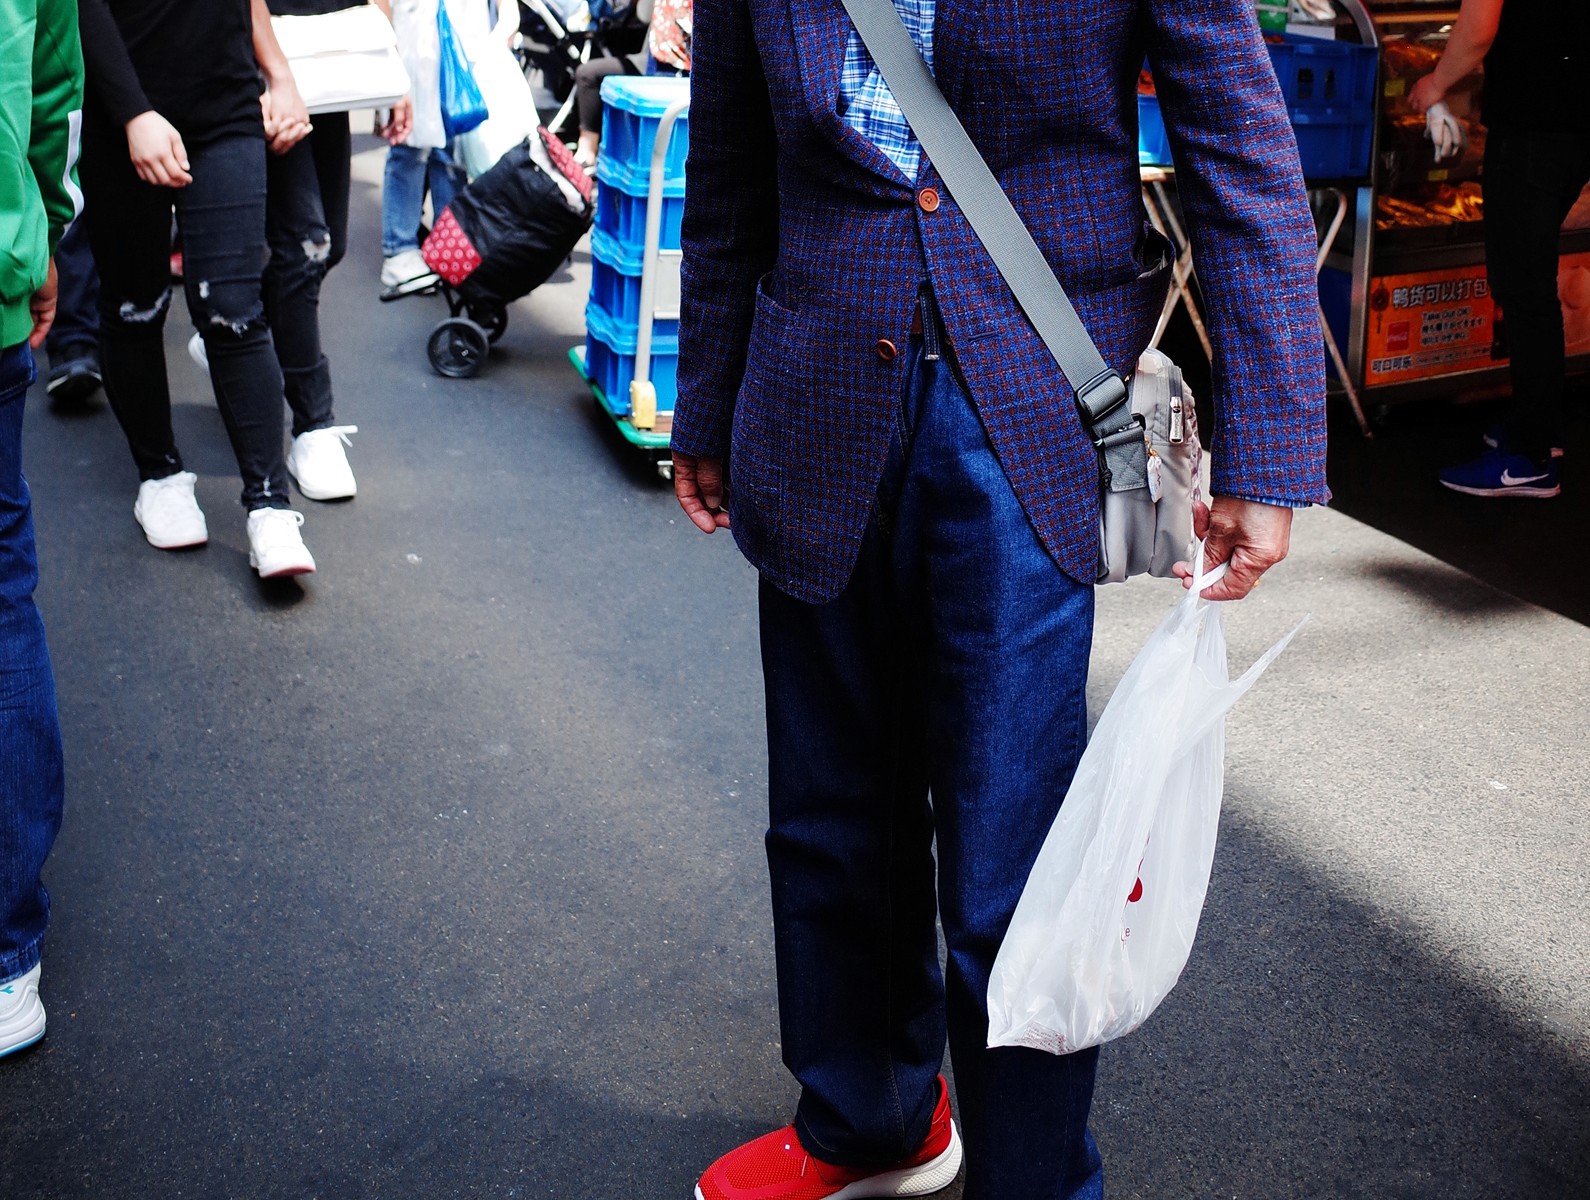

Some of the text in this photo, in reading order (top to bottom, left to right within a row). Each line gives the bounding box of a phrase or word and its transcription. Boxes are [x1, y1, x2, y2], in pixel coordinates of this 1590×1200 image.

[1393, 279, 1487, 307] 鸭货可以打包
[1372, 355, 1412, 373] 可口可乐
